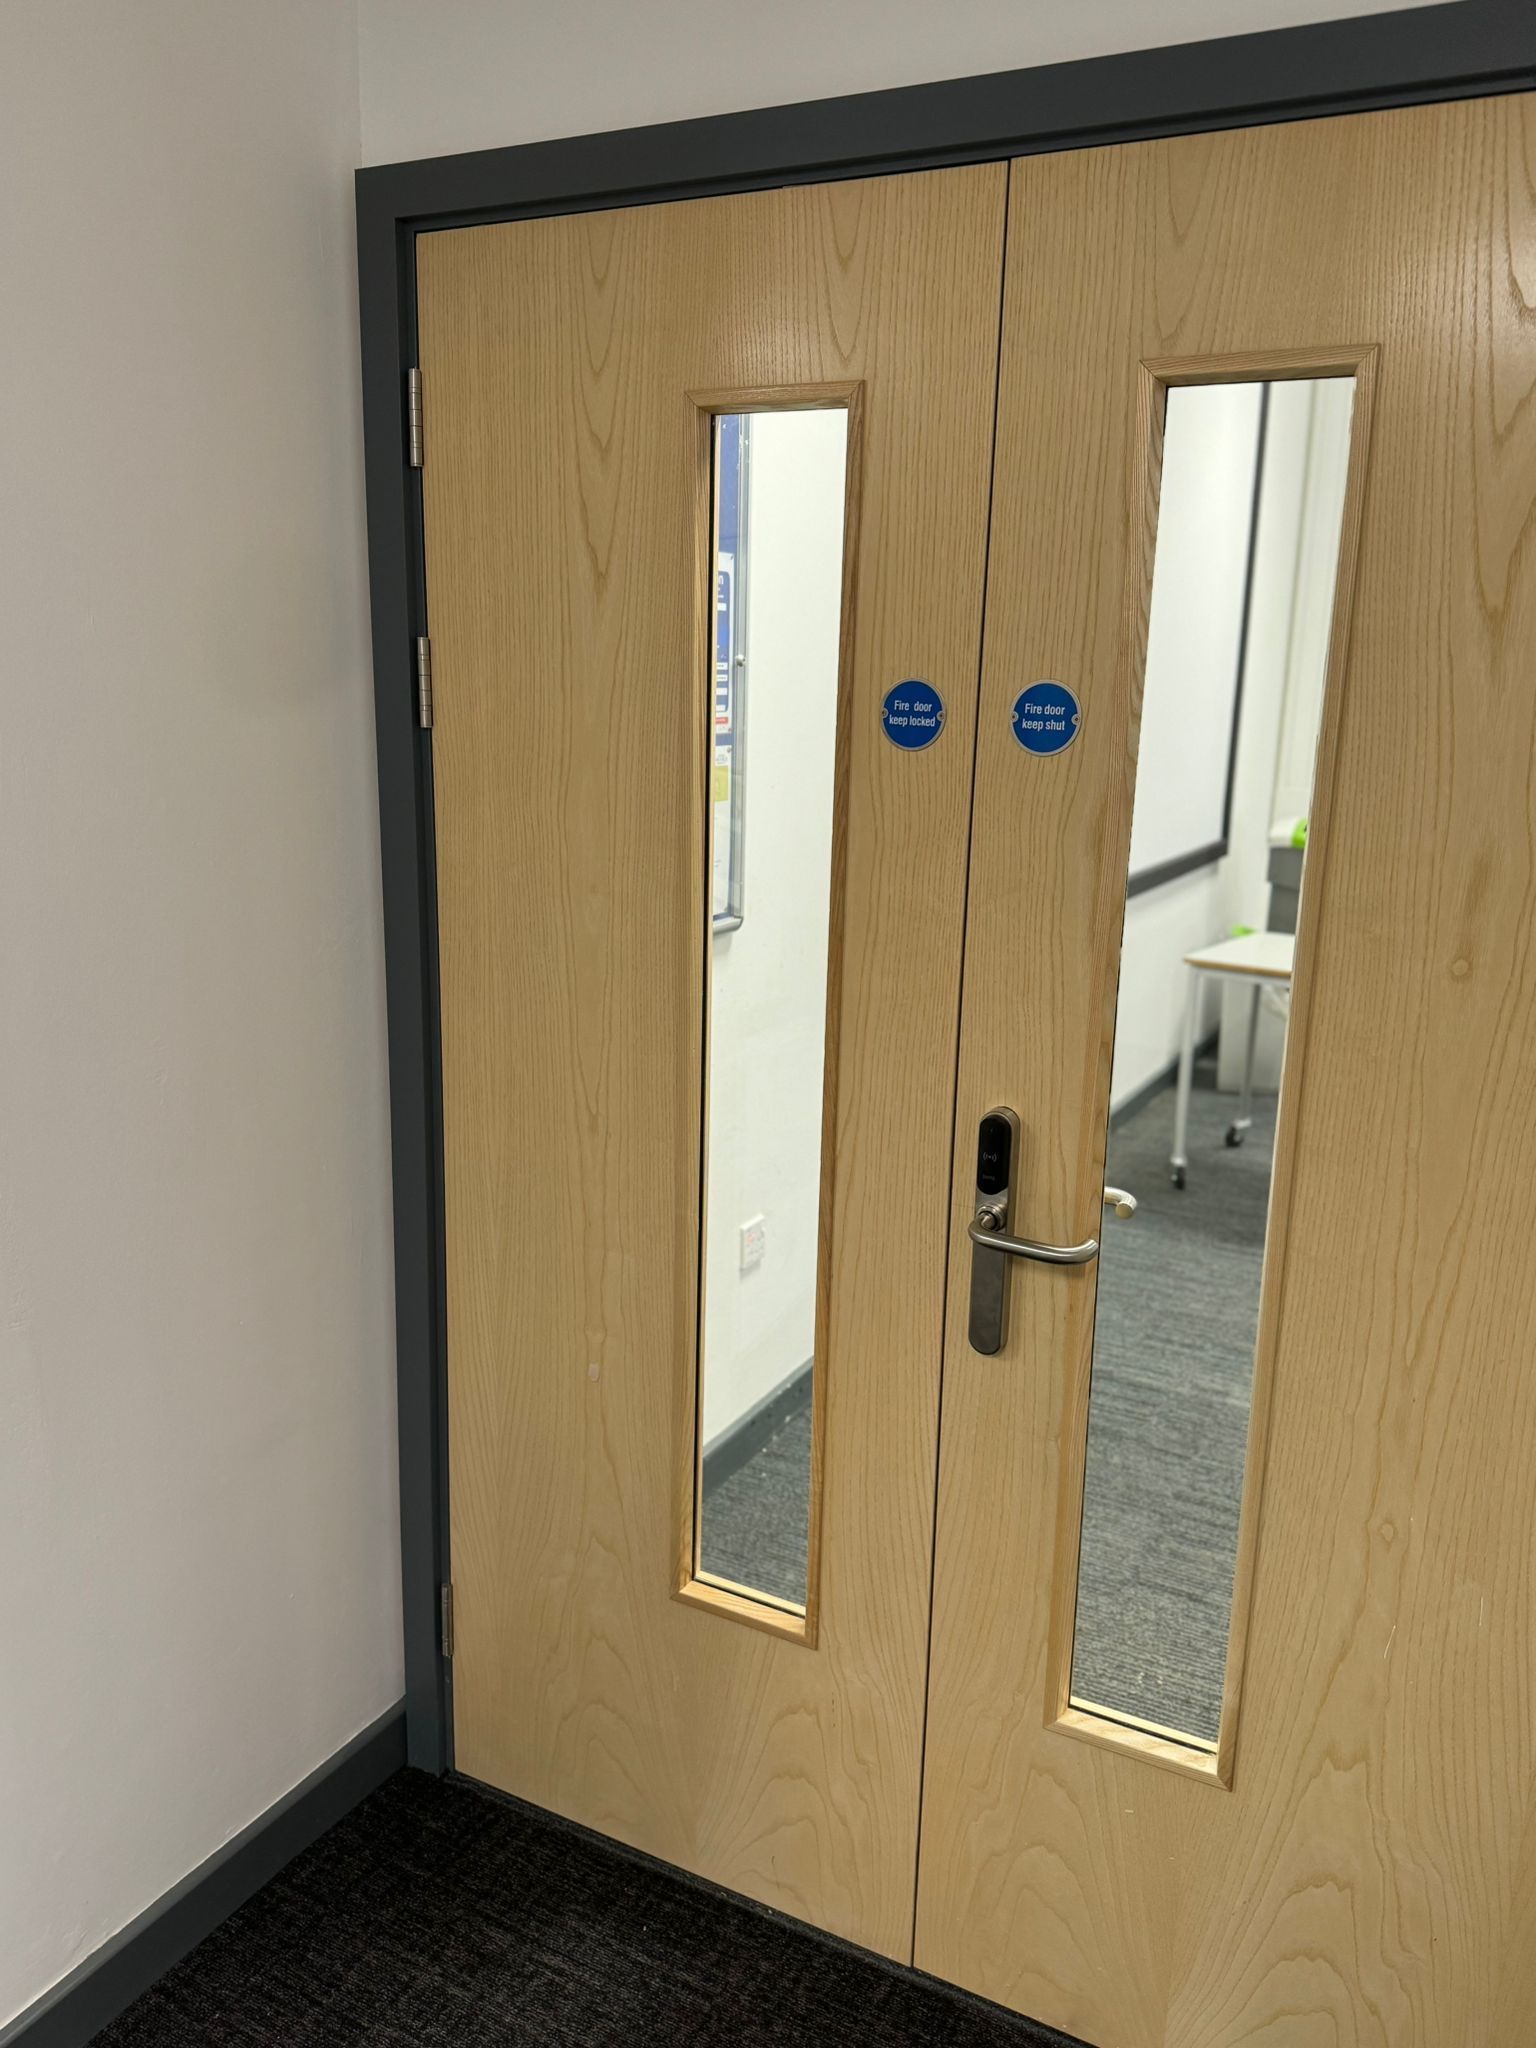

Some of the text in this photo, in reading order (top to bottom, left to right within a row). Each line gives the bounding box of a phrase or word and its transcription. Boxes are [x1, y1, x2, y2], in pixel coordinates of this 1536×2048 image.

[894, 700, 932, 712] Fire door
[1024, 703, 1065, 715] Fire door
[889, 714, 936, 727] keep locked
[1022, 718, 1065, 732] keep shut
